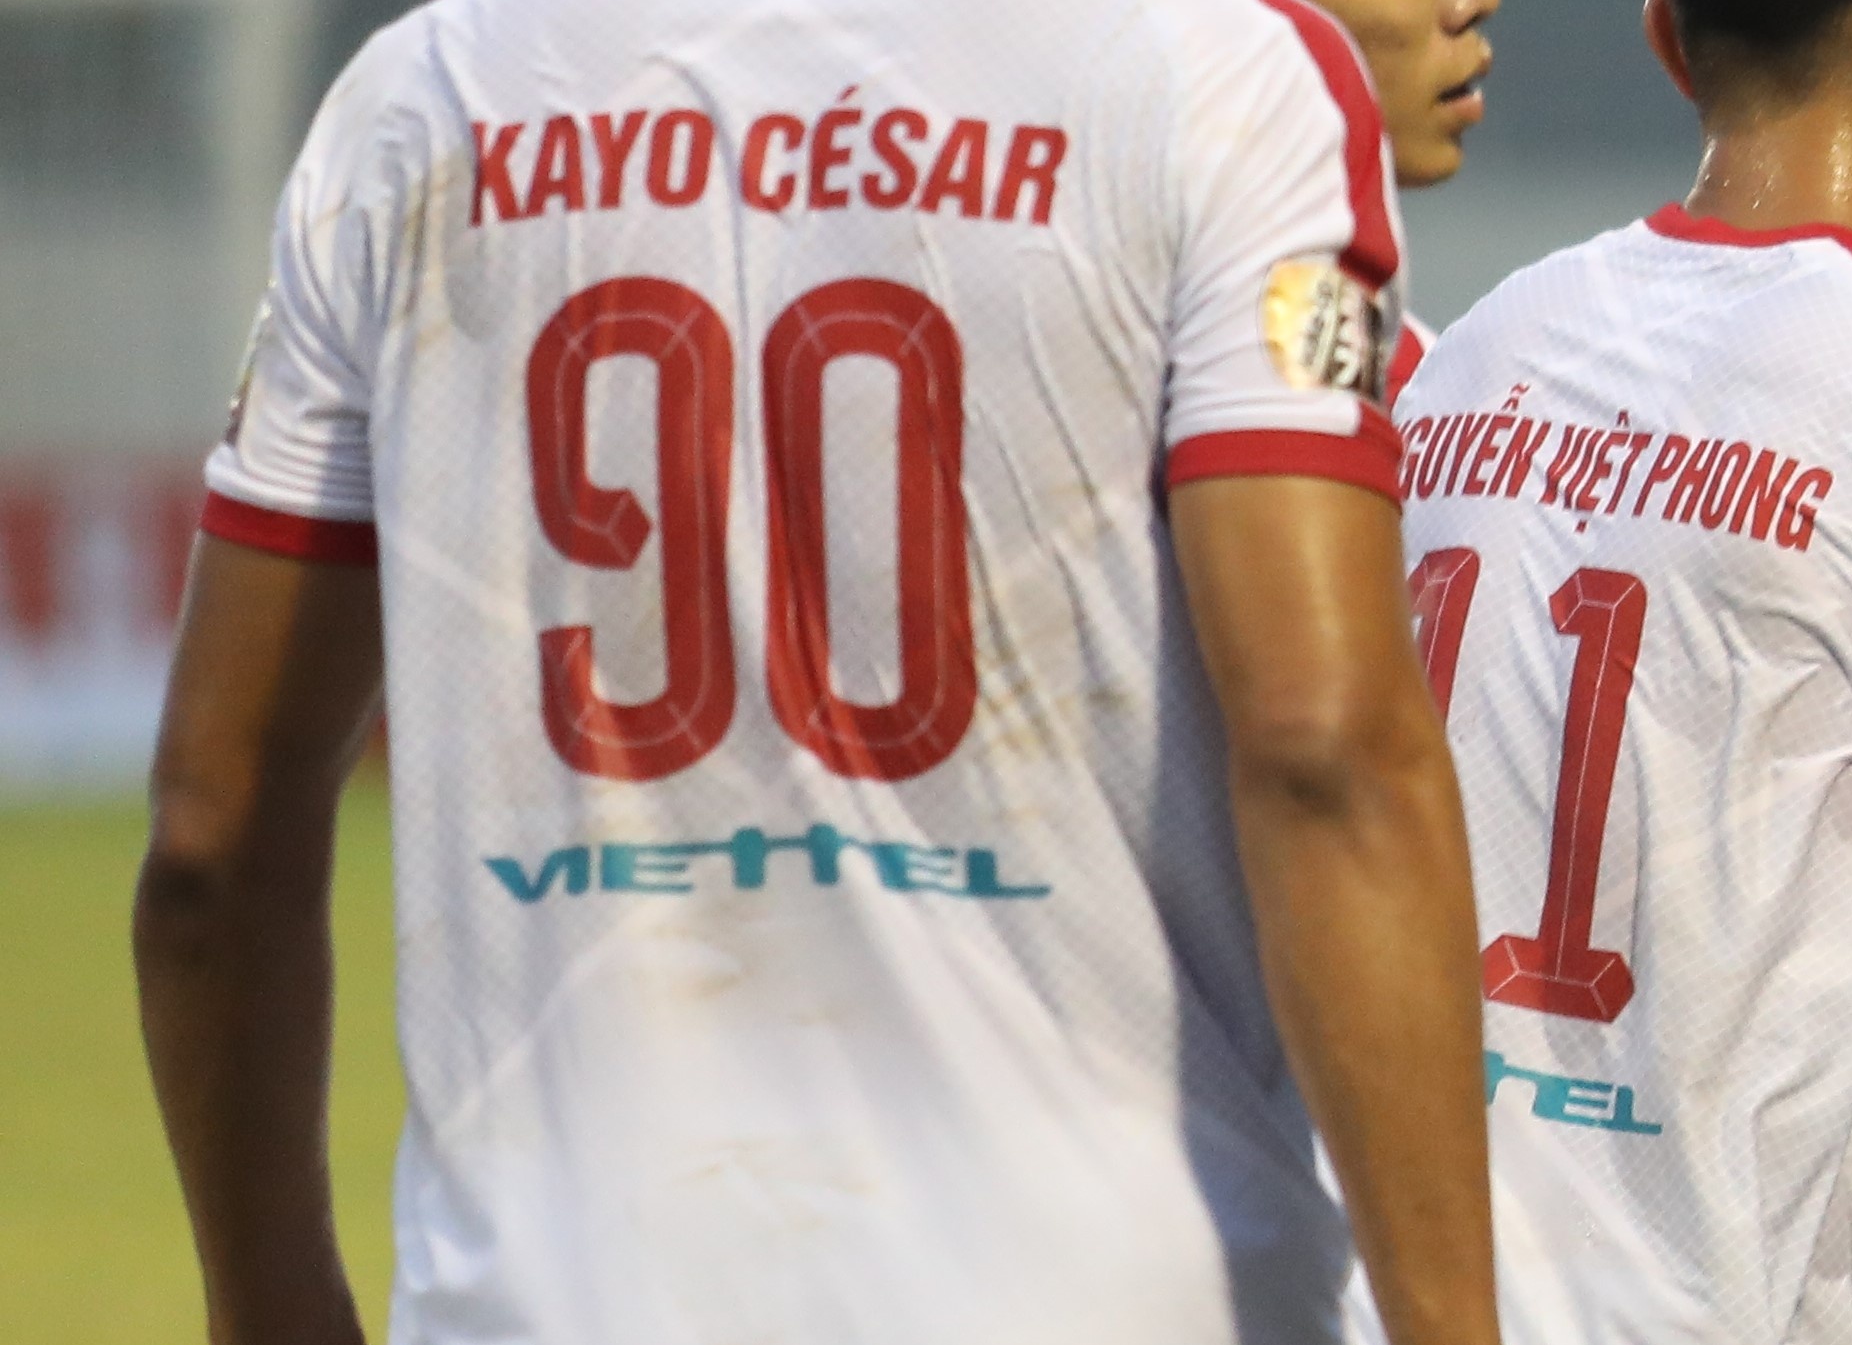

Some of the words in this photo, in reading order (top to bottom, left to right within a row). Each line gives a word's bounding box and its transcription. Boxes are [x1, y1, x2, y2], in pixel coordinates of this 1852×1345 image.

[471, 108, 716, 226] KAYO
[740, 87, 1068, 225] CÉSAR
[526, 275, 979, 782] 90
[1398, 383, 1552, 501] GUYỄN
[1539, 410, 1652, 533] VIỆT
[1631, 432, 1833, 553] PHONG
